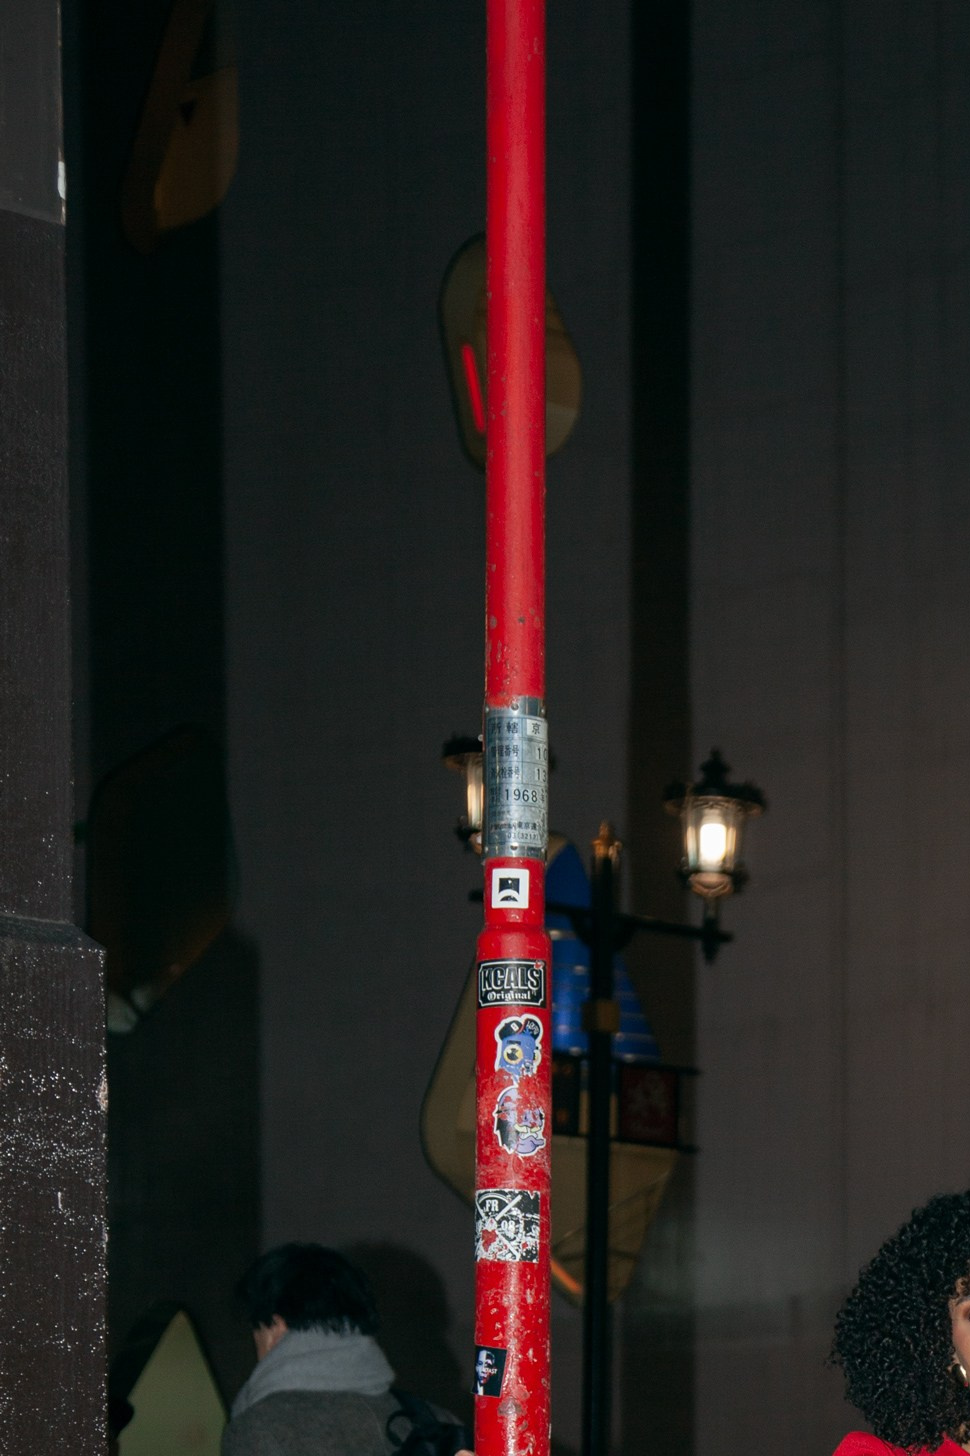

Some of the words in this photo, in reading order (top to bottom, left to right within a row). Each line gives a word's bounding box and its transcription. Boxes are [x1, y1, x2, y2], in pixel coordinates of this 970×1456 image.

[532, 723, 541, 735] 京
[505, 788, 538, 803] 1968
[481, 966, 541, 992] KCALS
[487, 990, 532, 1002] Original
